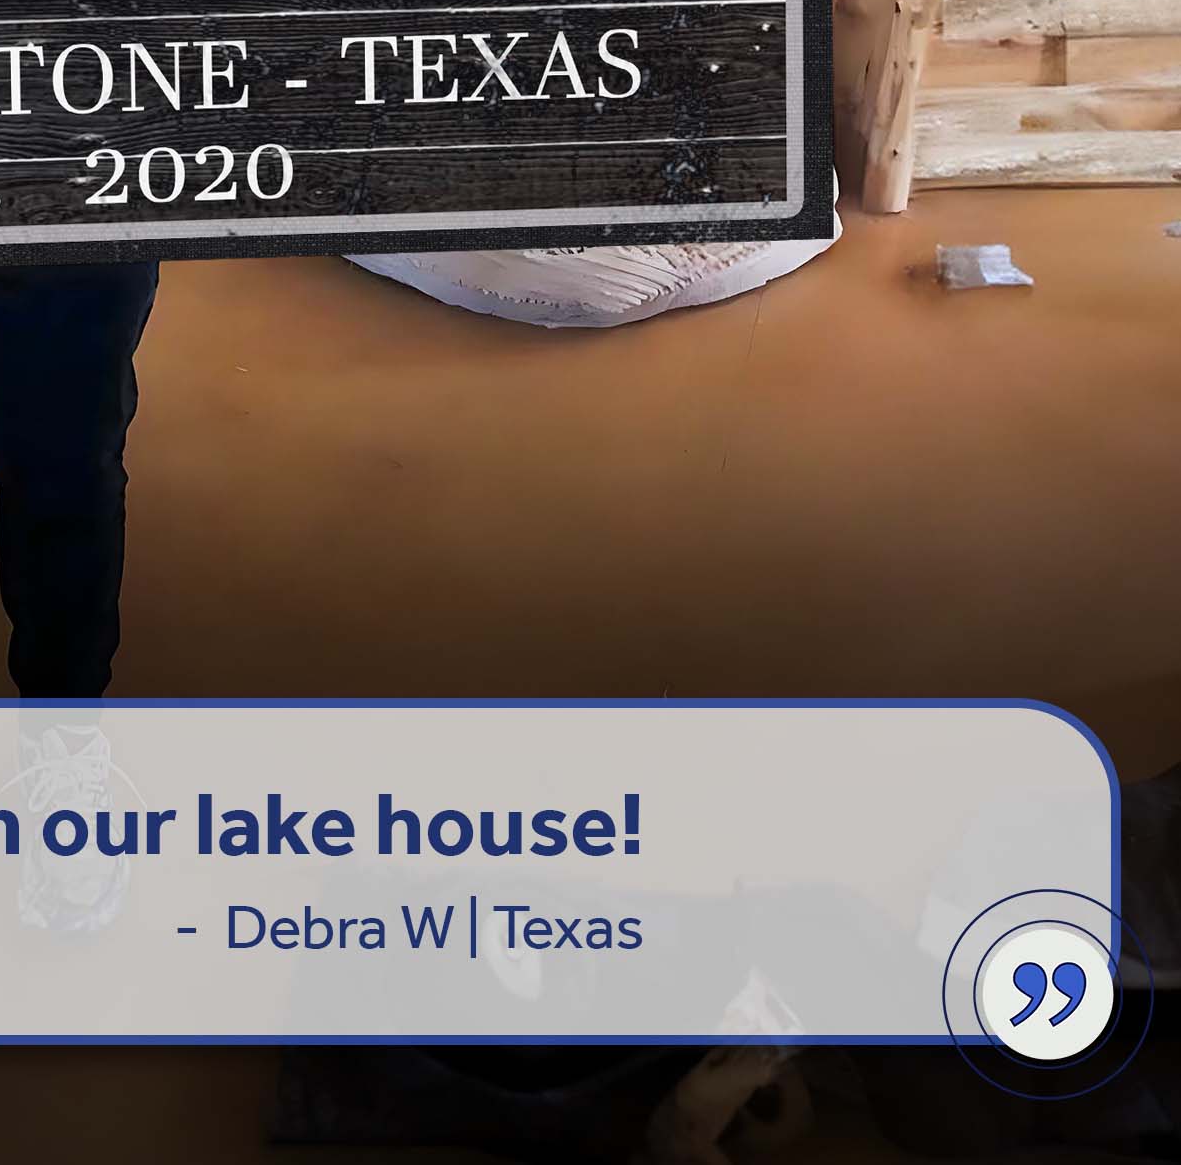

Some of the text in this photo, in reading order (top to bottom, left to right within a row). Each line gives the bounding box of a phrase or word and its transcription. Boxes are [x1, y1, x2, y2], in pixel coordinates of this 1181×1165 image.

[285, 79, 308, 89] -
[340, 28, 643, 105] TEXAS
[84, 143, 294, 206] 2020
